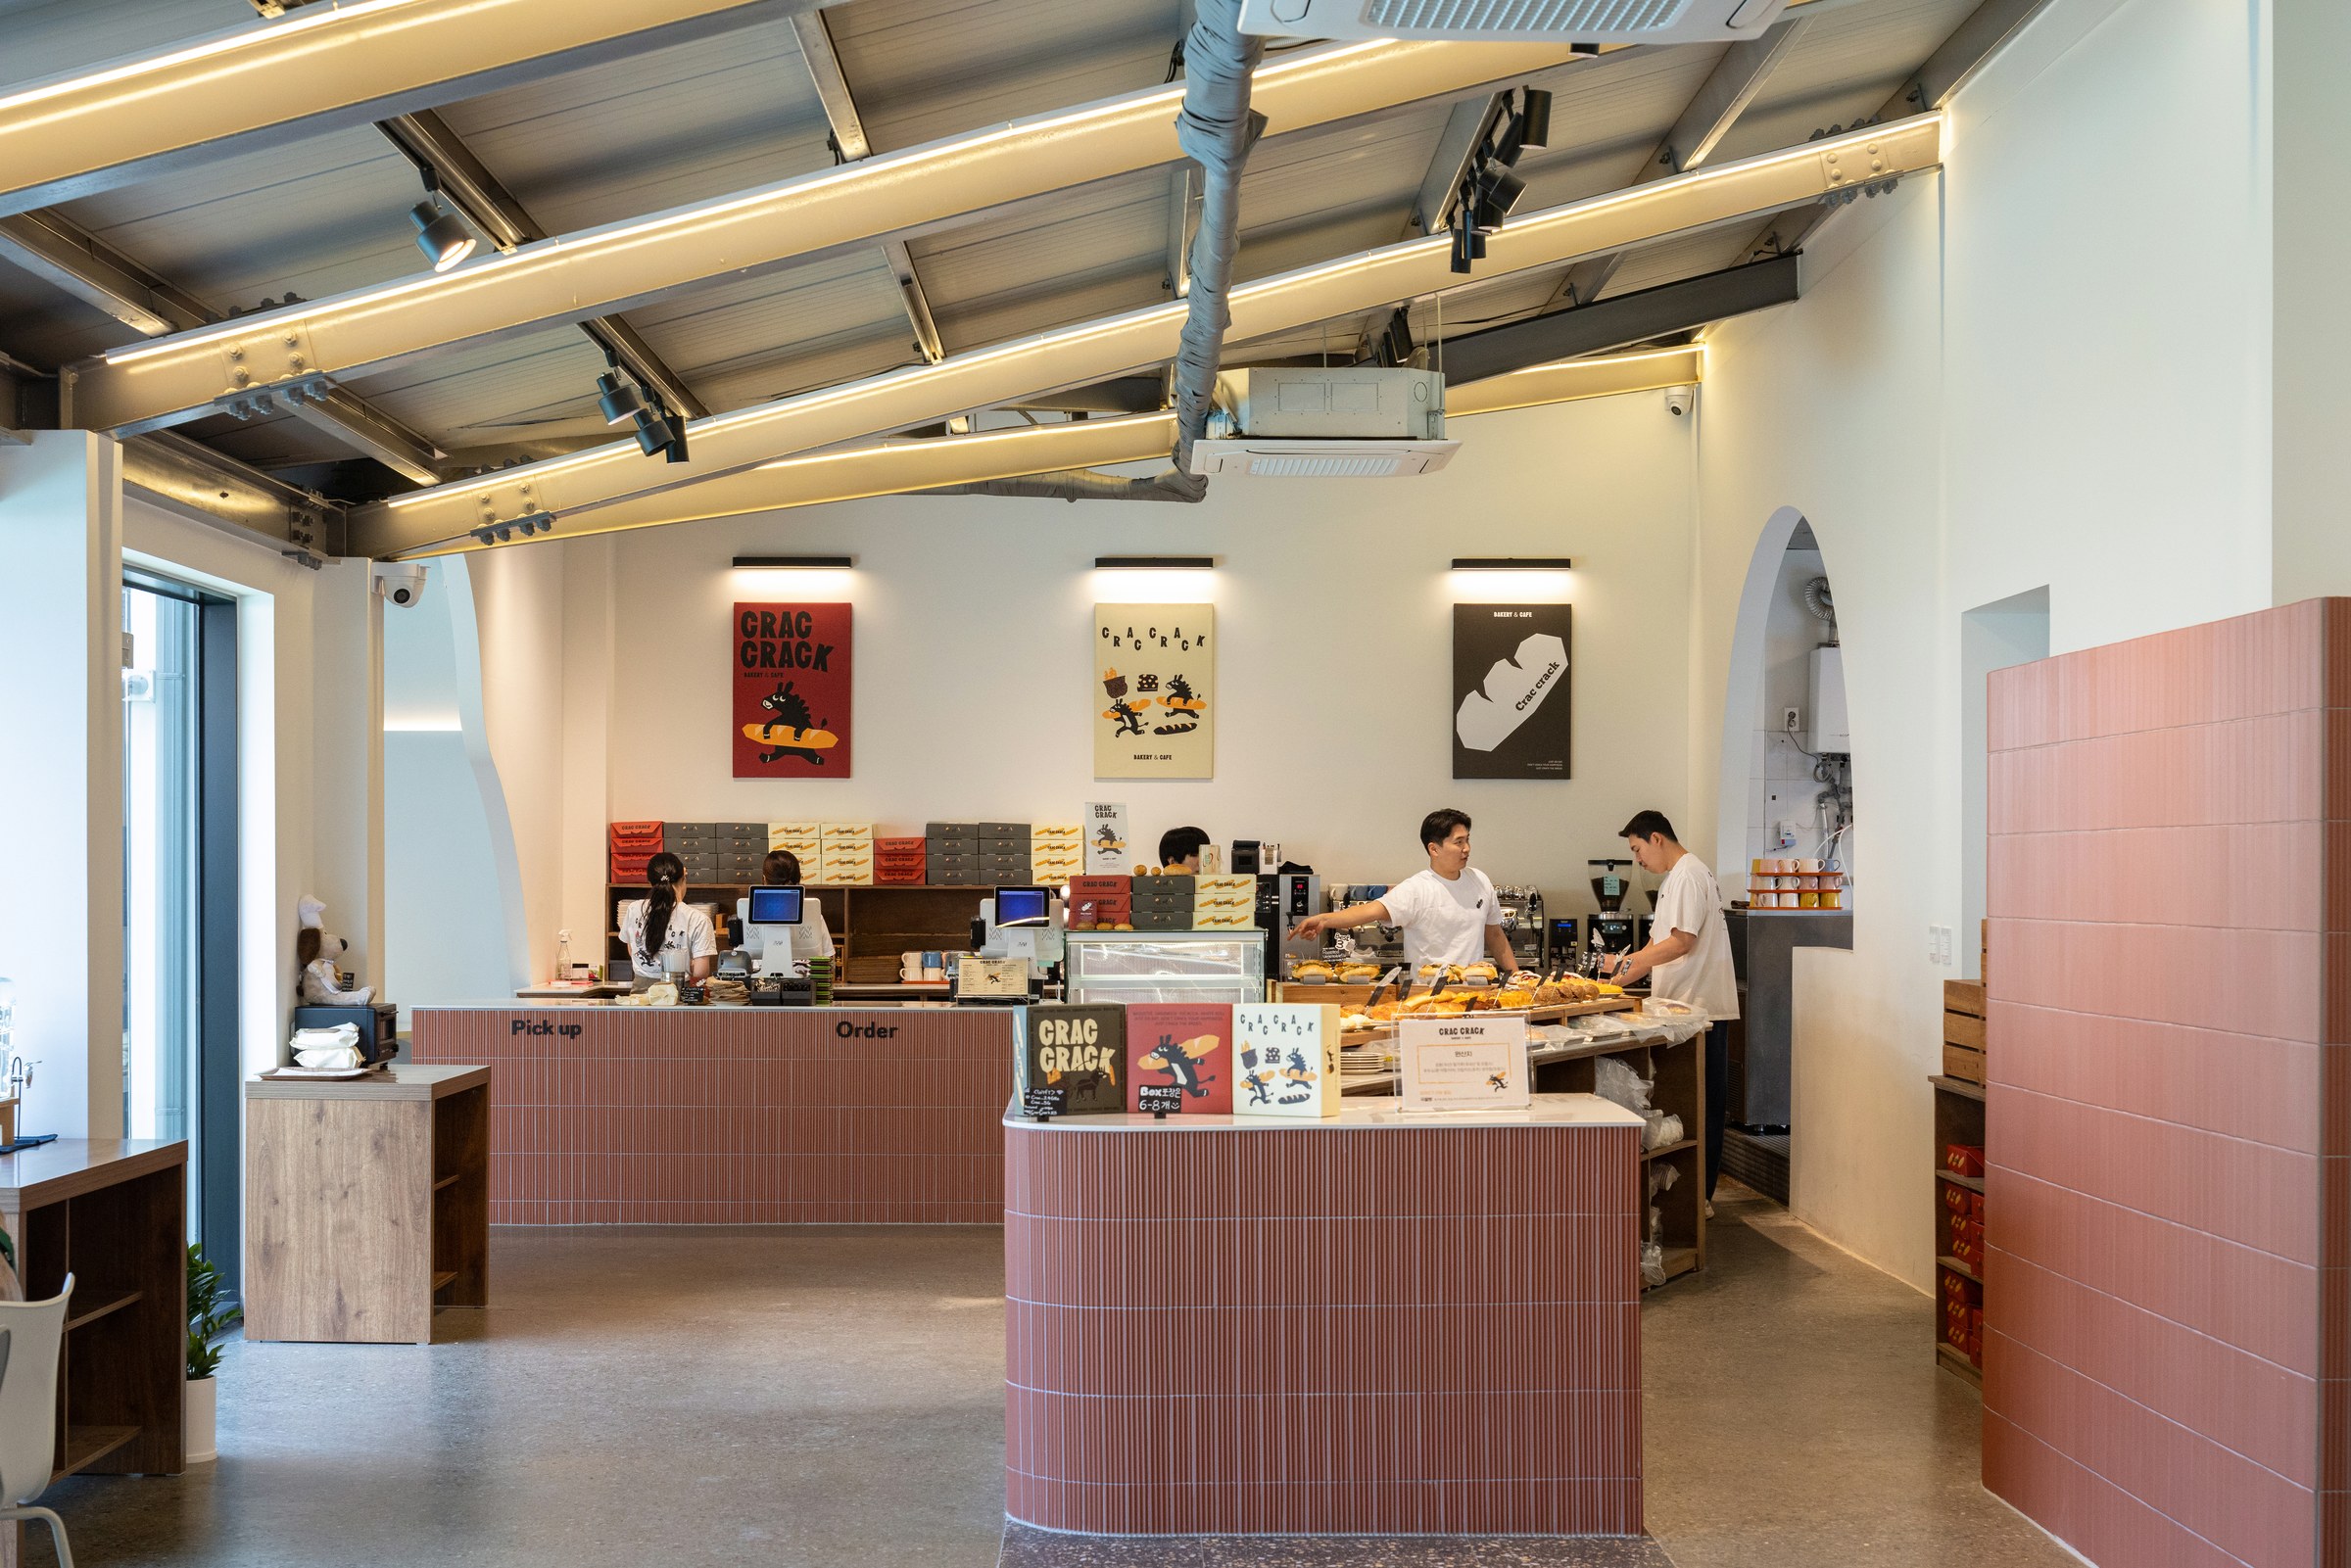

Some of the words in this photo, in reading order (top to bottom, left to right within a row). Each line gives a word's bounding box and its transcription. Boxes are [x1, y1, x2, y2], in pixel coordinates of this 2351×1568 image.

[741, 611, 812, 639] CRAC
[741, 641, 835, 672] CRACK
[1515, 689, 1537, 711] Crac
[1535, 662, 1559, 689] crack
[512, 1020, 553, 1035] Pick
[558, 1024, 582, 1039] up
[837, 1022, 898, 1038] Order
[1039, 1019, 1097, 1046] CRAC
[1039, 1046, 1116, 1073] CRACK
